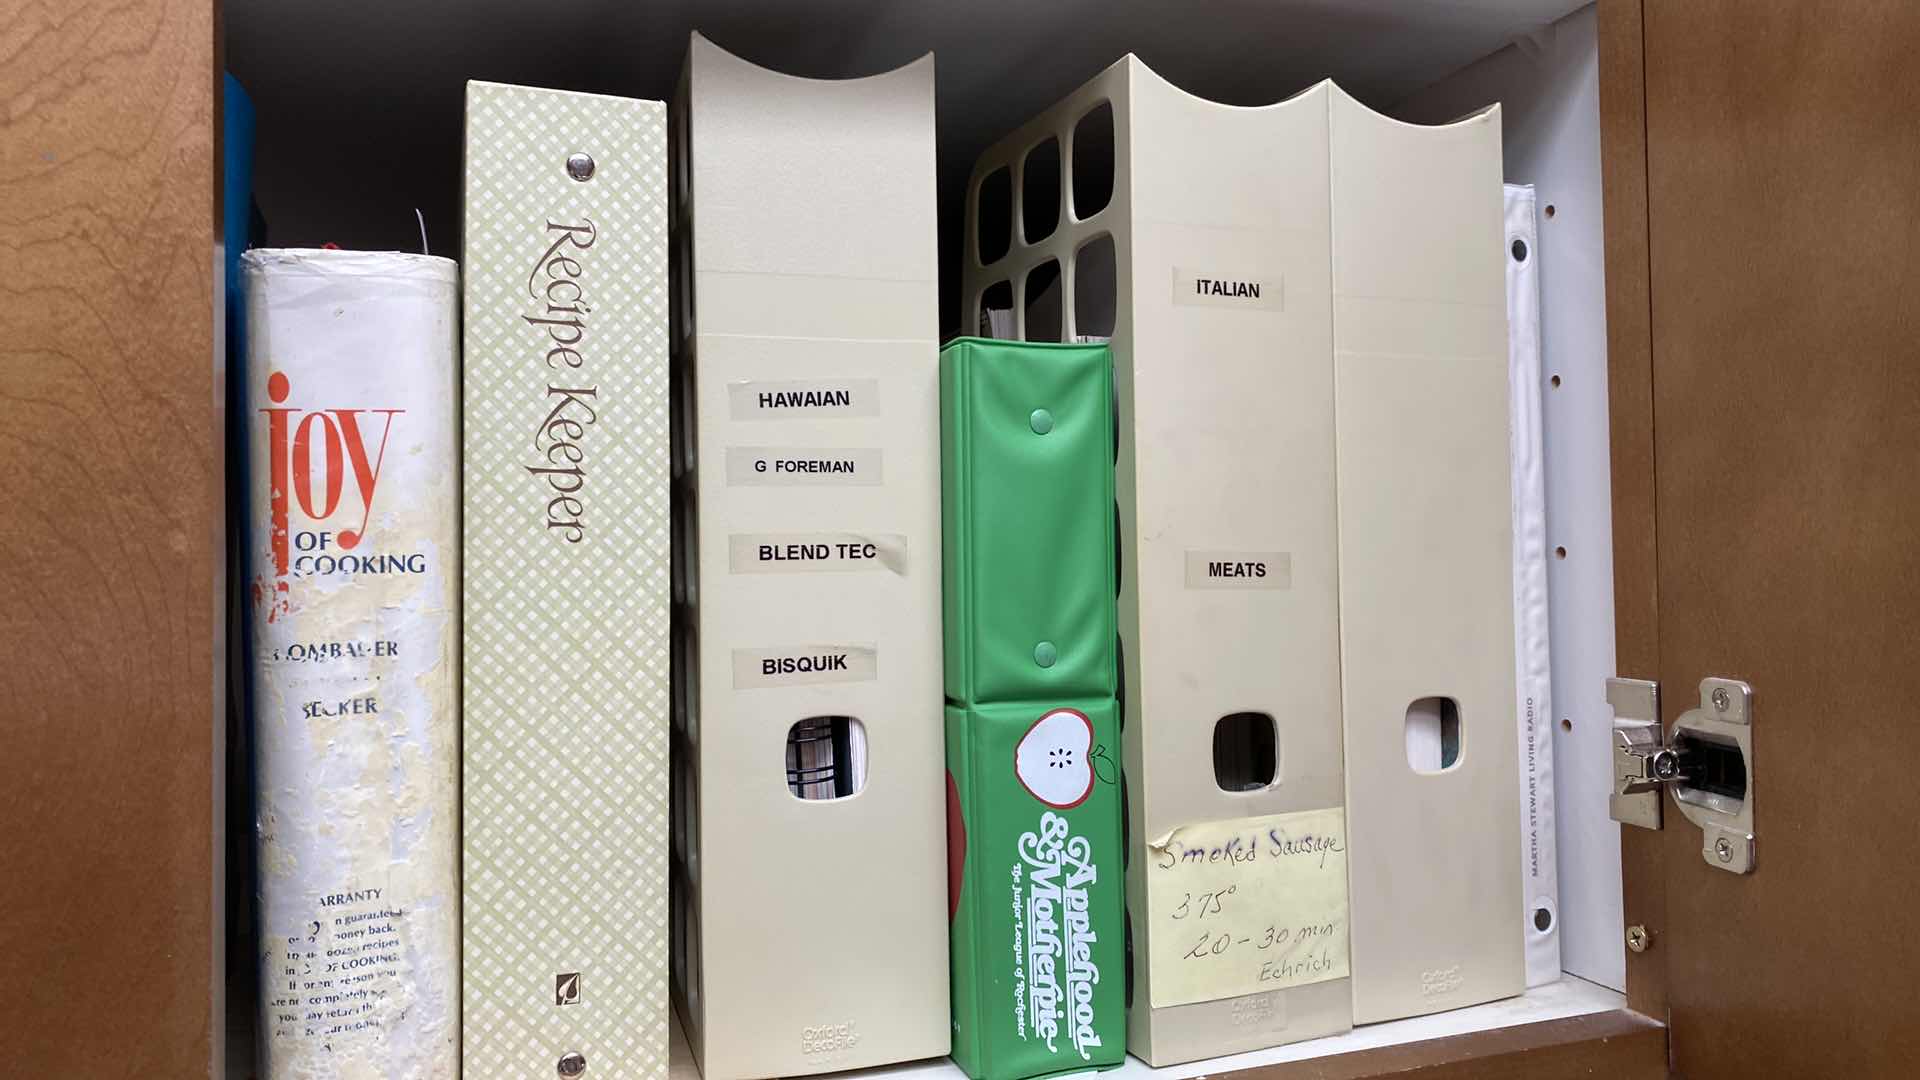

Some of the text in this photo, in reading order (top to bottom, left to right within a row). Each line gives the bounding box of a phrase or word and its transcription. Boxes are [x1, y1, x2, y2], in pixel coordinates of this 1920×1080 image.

[1196, 279, 1260, 298] ITALIAN
[521, 218, 597, 544] Recipe Keeper
[758, 391, 850, 408] HAWAIAN
[755, 460, 855, 473] G FOREMAN
[295, 531, 332, 551] OF
[759, 544, 876, 561] BLEND TEC
[293, 554, 426, 575] COOKING
[1208, 562, 1266, 577] MEATS
[273, 641, 398, 663] OMBAER
[762, 654, 848, 675] BISQUIK
[1527, 736, 1535, 772] LIVING
[1529, 776, 1537, 827] STEWART
[1269, 829, 1345, 869] Sausage
[1530, 830, 1538, 877] MARTHA
[1018, 811, 1068, 1053] & Motherpie
[1011, 863, 1027, 1041] The Junior League of Rochester
[1062, 836, 1102, 1060] Applehood
